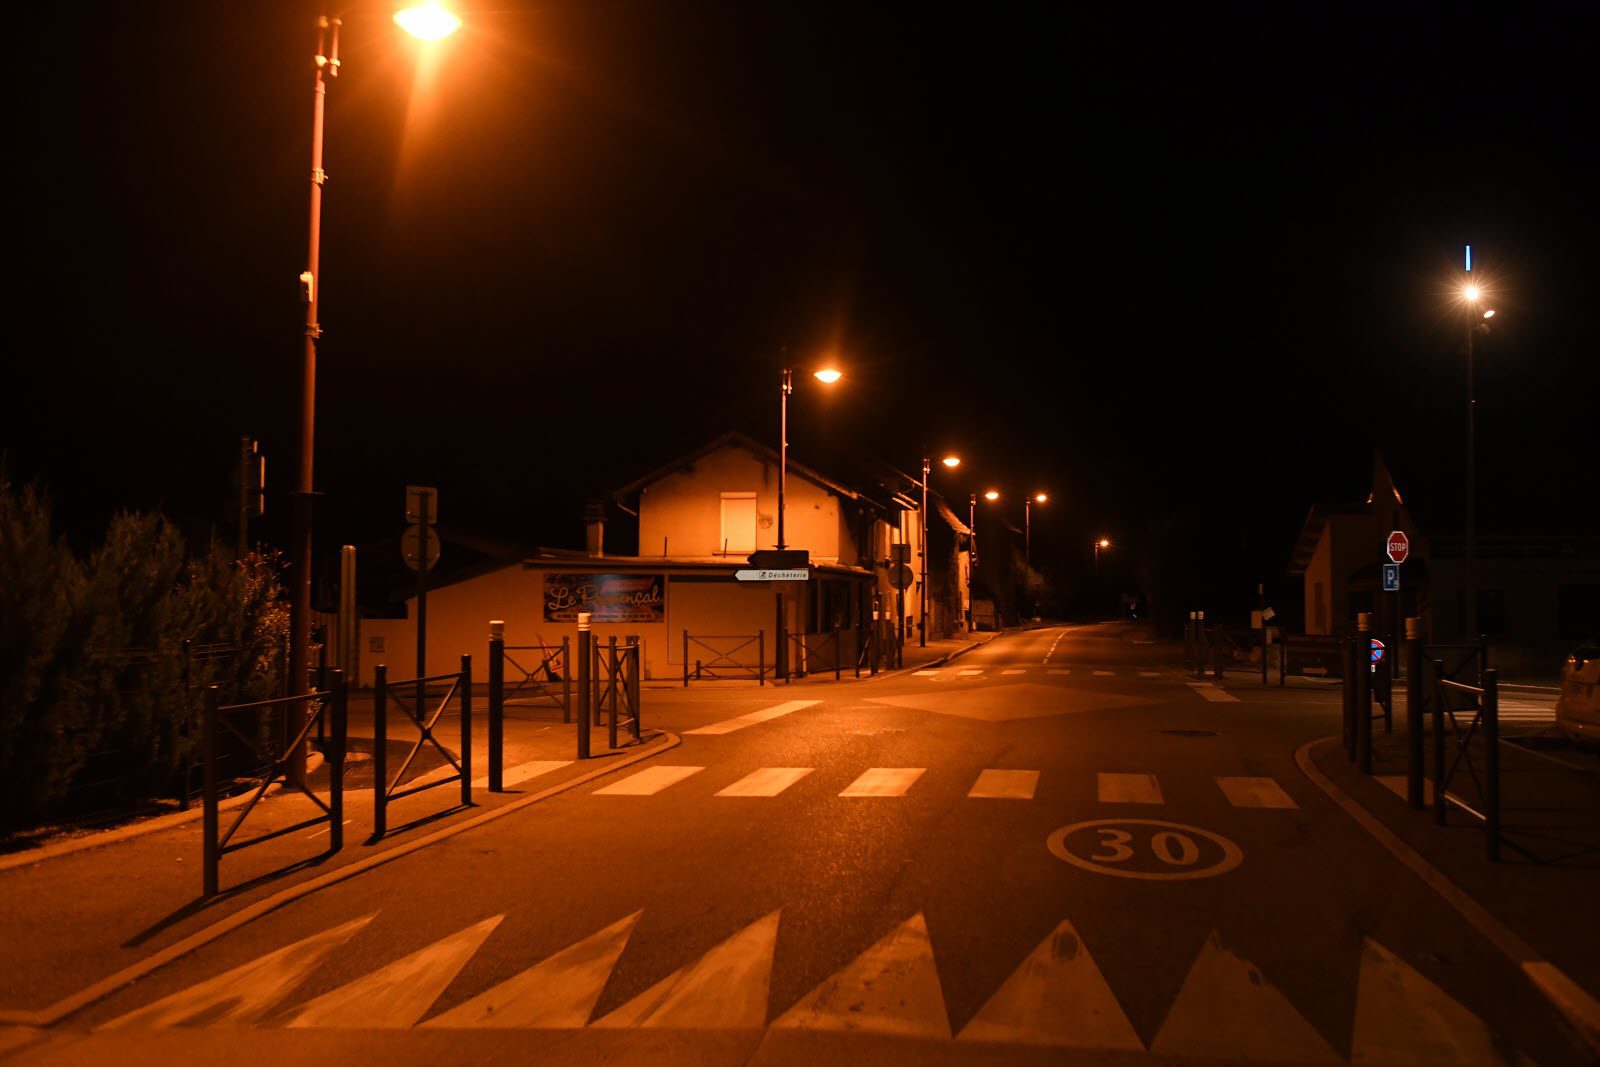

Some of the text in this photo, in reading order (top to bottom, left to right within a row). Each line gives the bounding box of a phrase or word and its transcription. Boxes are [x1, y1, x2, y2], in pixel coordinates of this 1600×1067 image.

[1390, 542, 1406, 552] STOP
[1387, 569, 1395, 585] P
[548, 587, 577, 611] Le
[1091, 828, 1200, 866] 30
